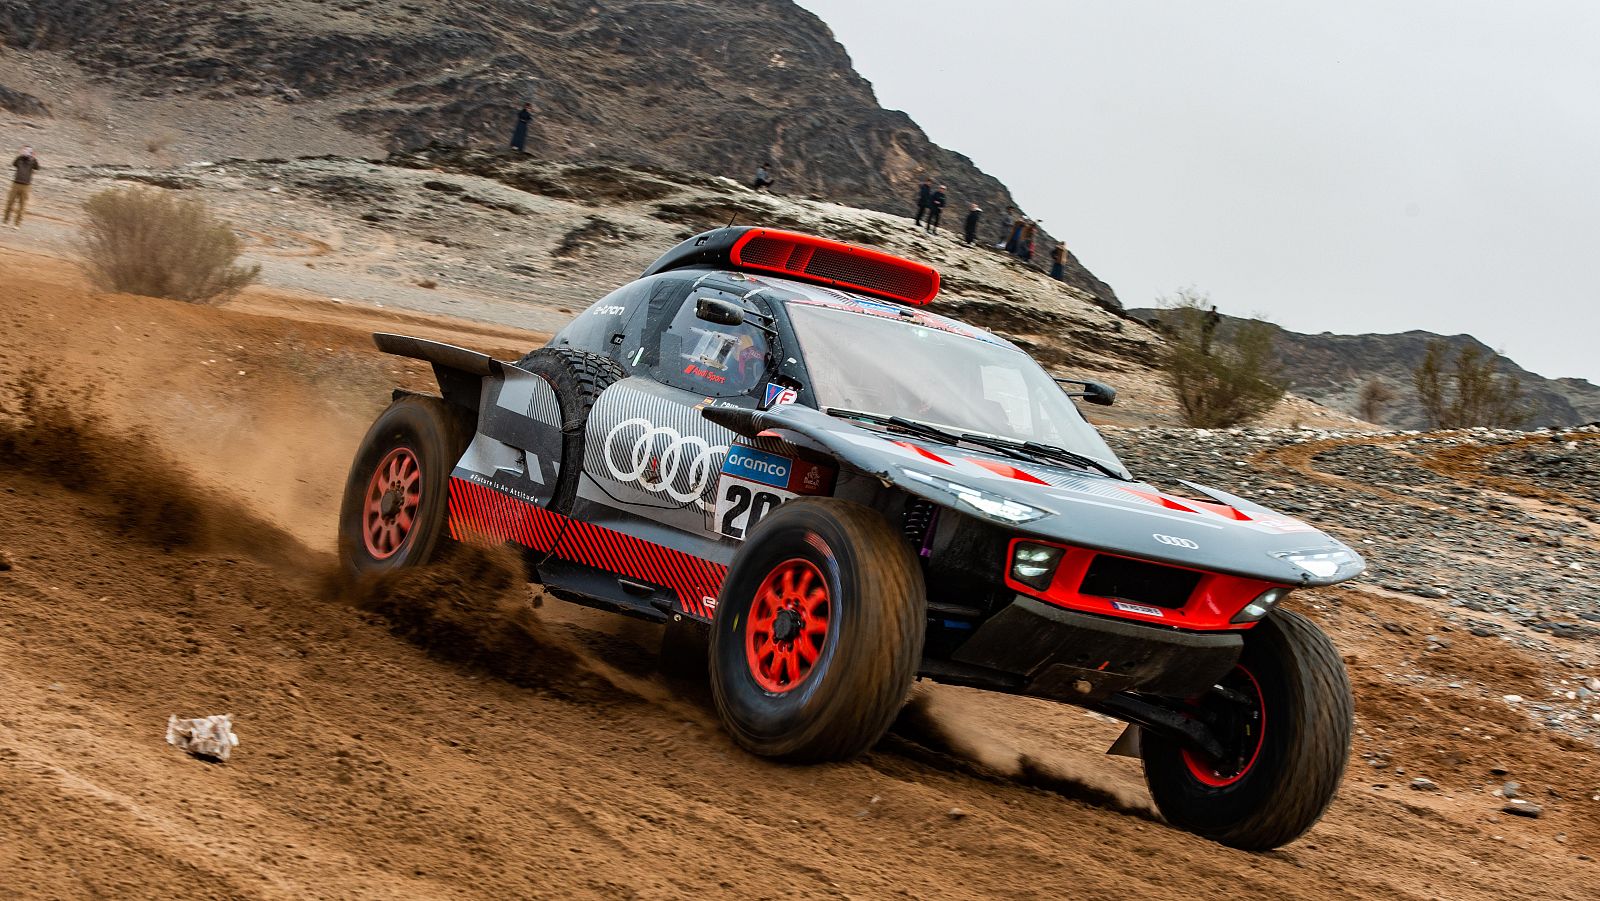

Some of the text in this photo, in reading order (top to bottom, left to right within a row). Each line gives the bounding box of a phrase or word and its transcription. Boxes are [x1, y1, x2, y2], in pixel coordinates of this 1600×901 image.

[592, 305, 625, 316] e-tron
[693, 367, 726, 383] Audi Sport
[728, 454, 786, 477] aramco
[470, 474, 492, 486] #Future
[510, 488, 538, 503] Attitude
[722, 485, 792, 538] 20
